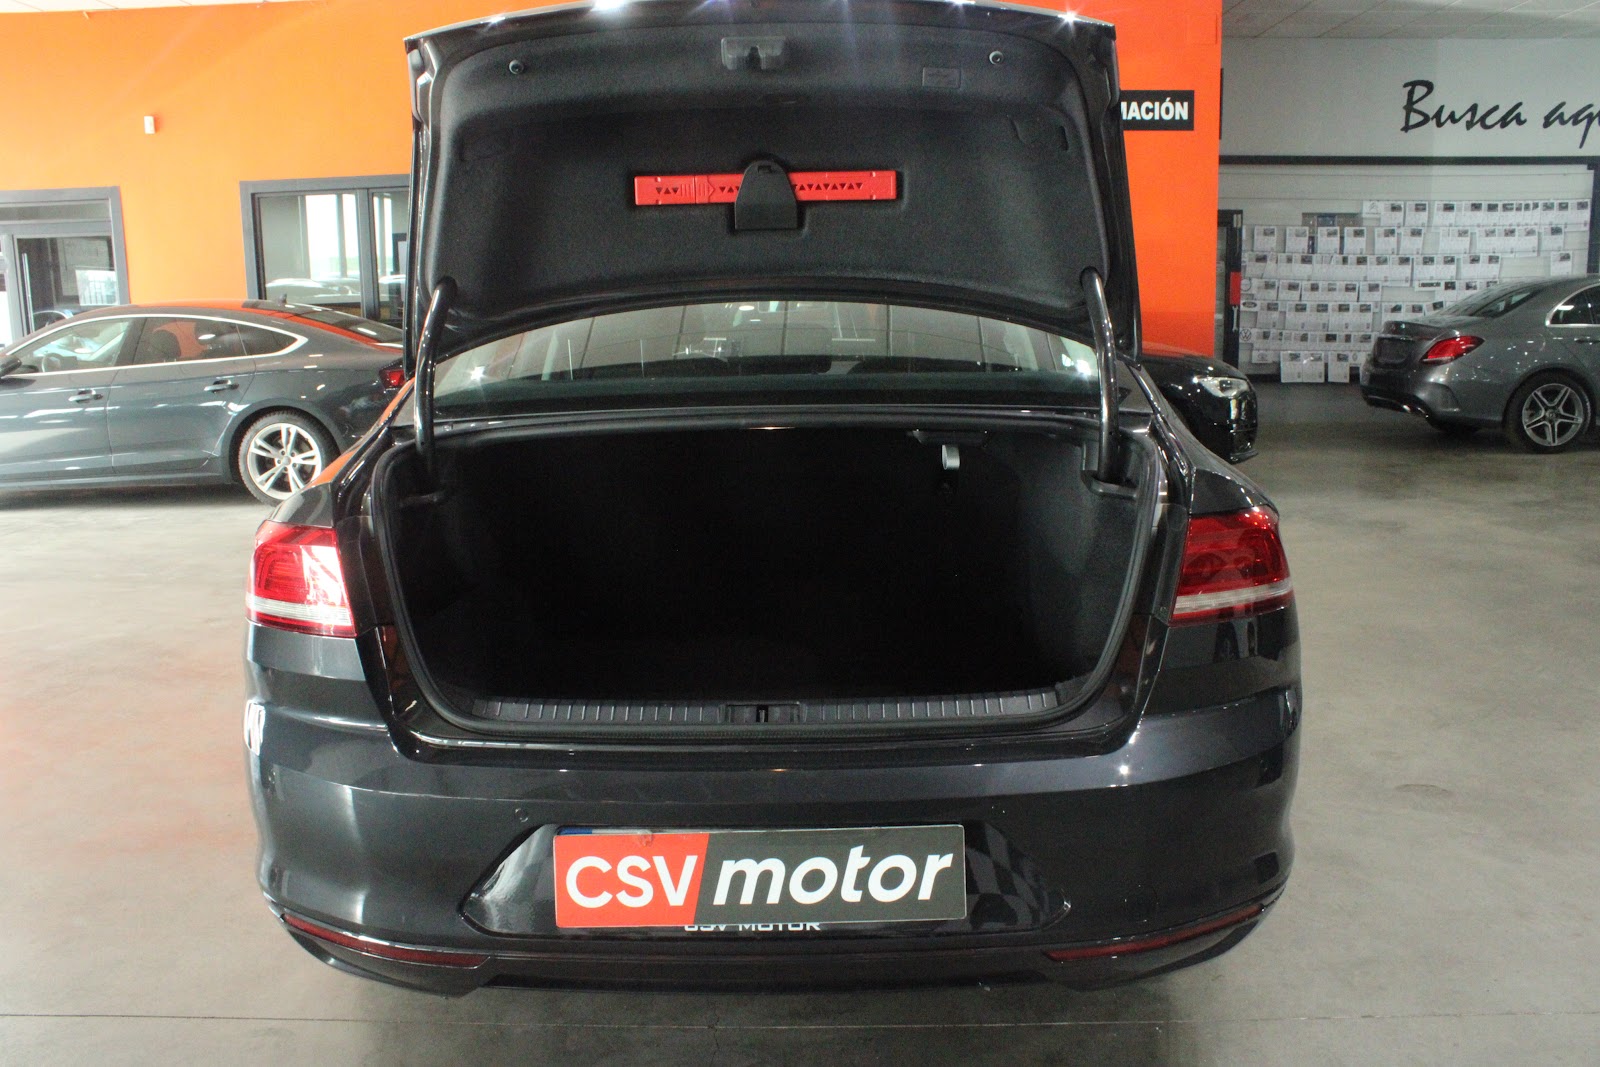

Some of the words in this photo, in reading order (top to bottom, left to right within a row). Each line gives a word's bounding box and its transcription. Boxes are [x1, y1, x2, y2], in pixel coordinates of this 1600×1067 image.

[1400, 80, 1527, 133] Busca
[1543, 102, 1600, 148] aq
[566, 855, 697, 908] CSV
[713, 845, 953, 905] motor
